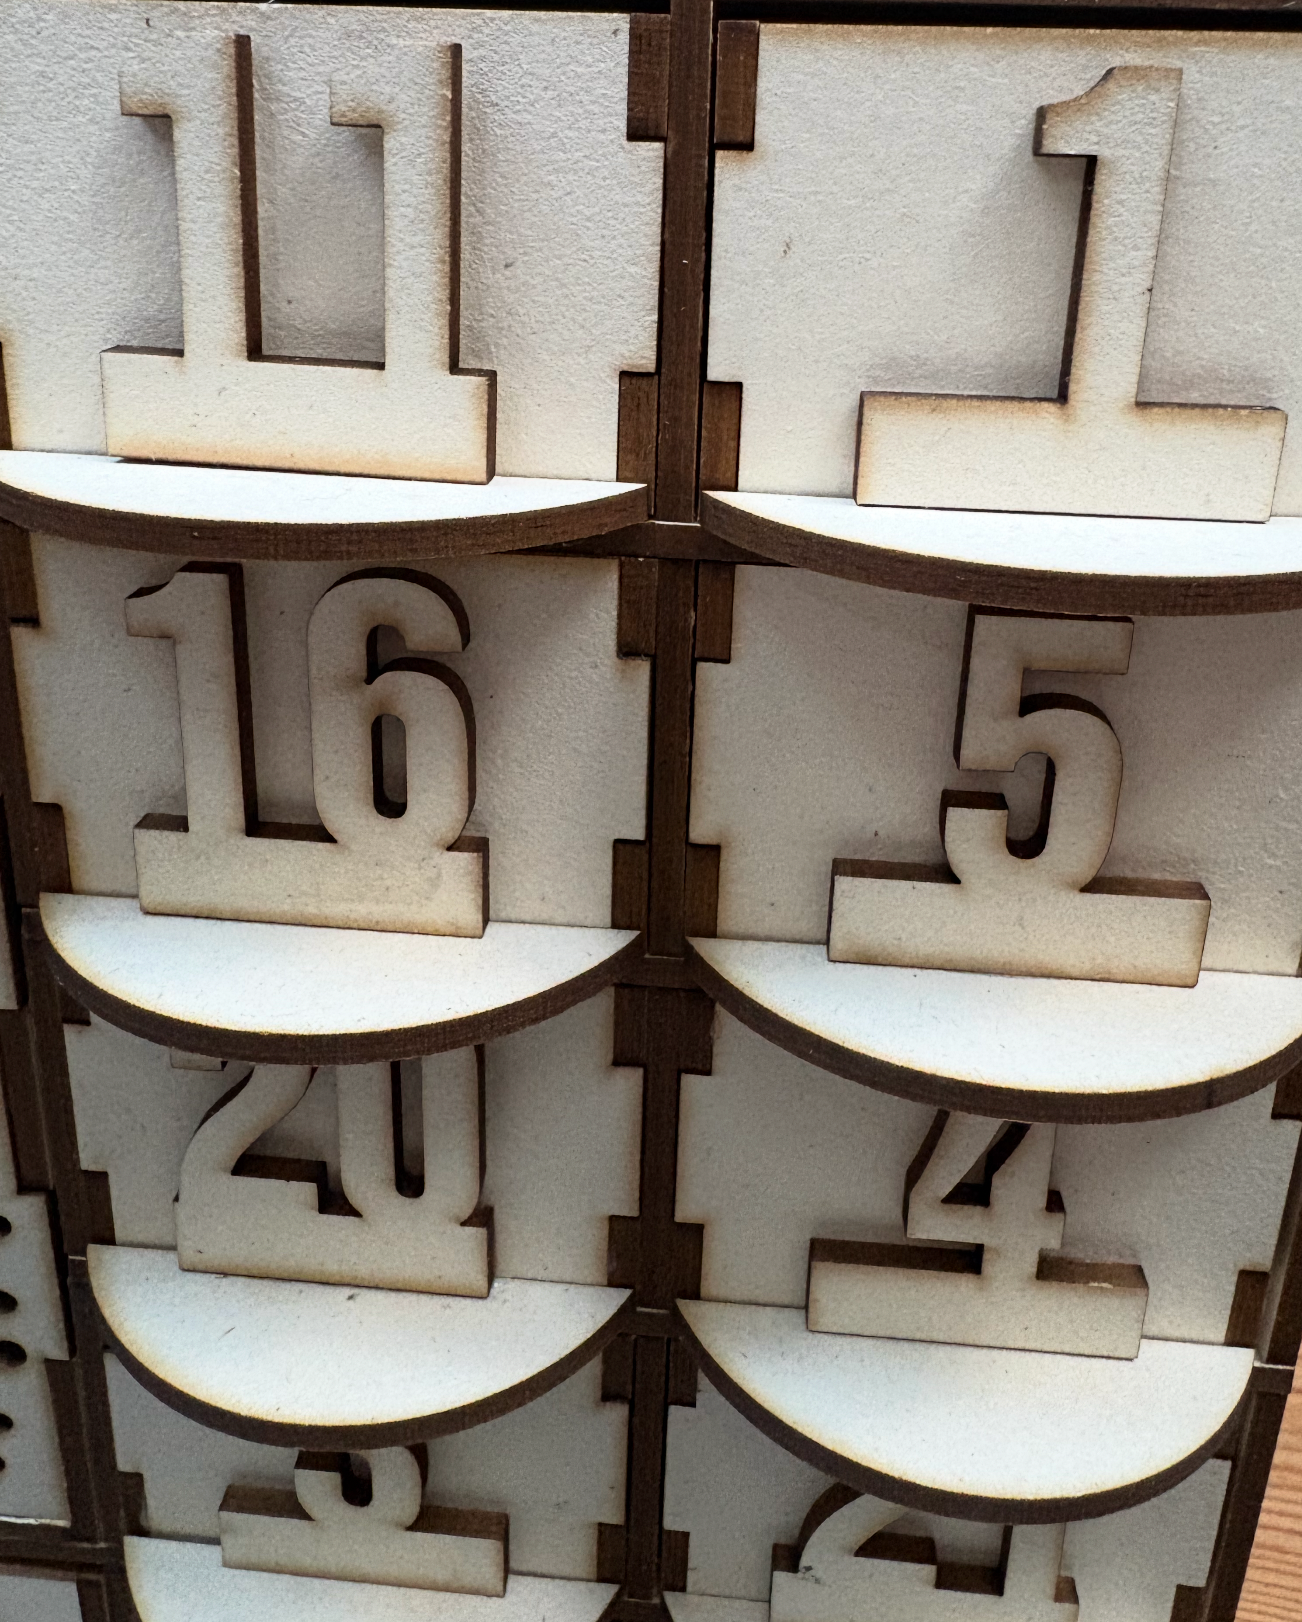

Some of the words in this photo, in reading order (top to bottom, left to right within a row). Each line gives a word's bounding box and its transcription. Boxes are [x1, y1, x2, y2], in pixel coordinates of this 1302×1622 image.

[119, 33, 463, 375] 11
[1033, 65, 1183, 404] 1
[125, 561, 477, 852] 16
[938, 602, 1134, 893] 5
